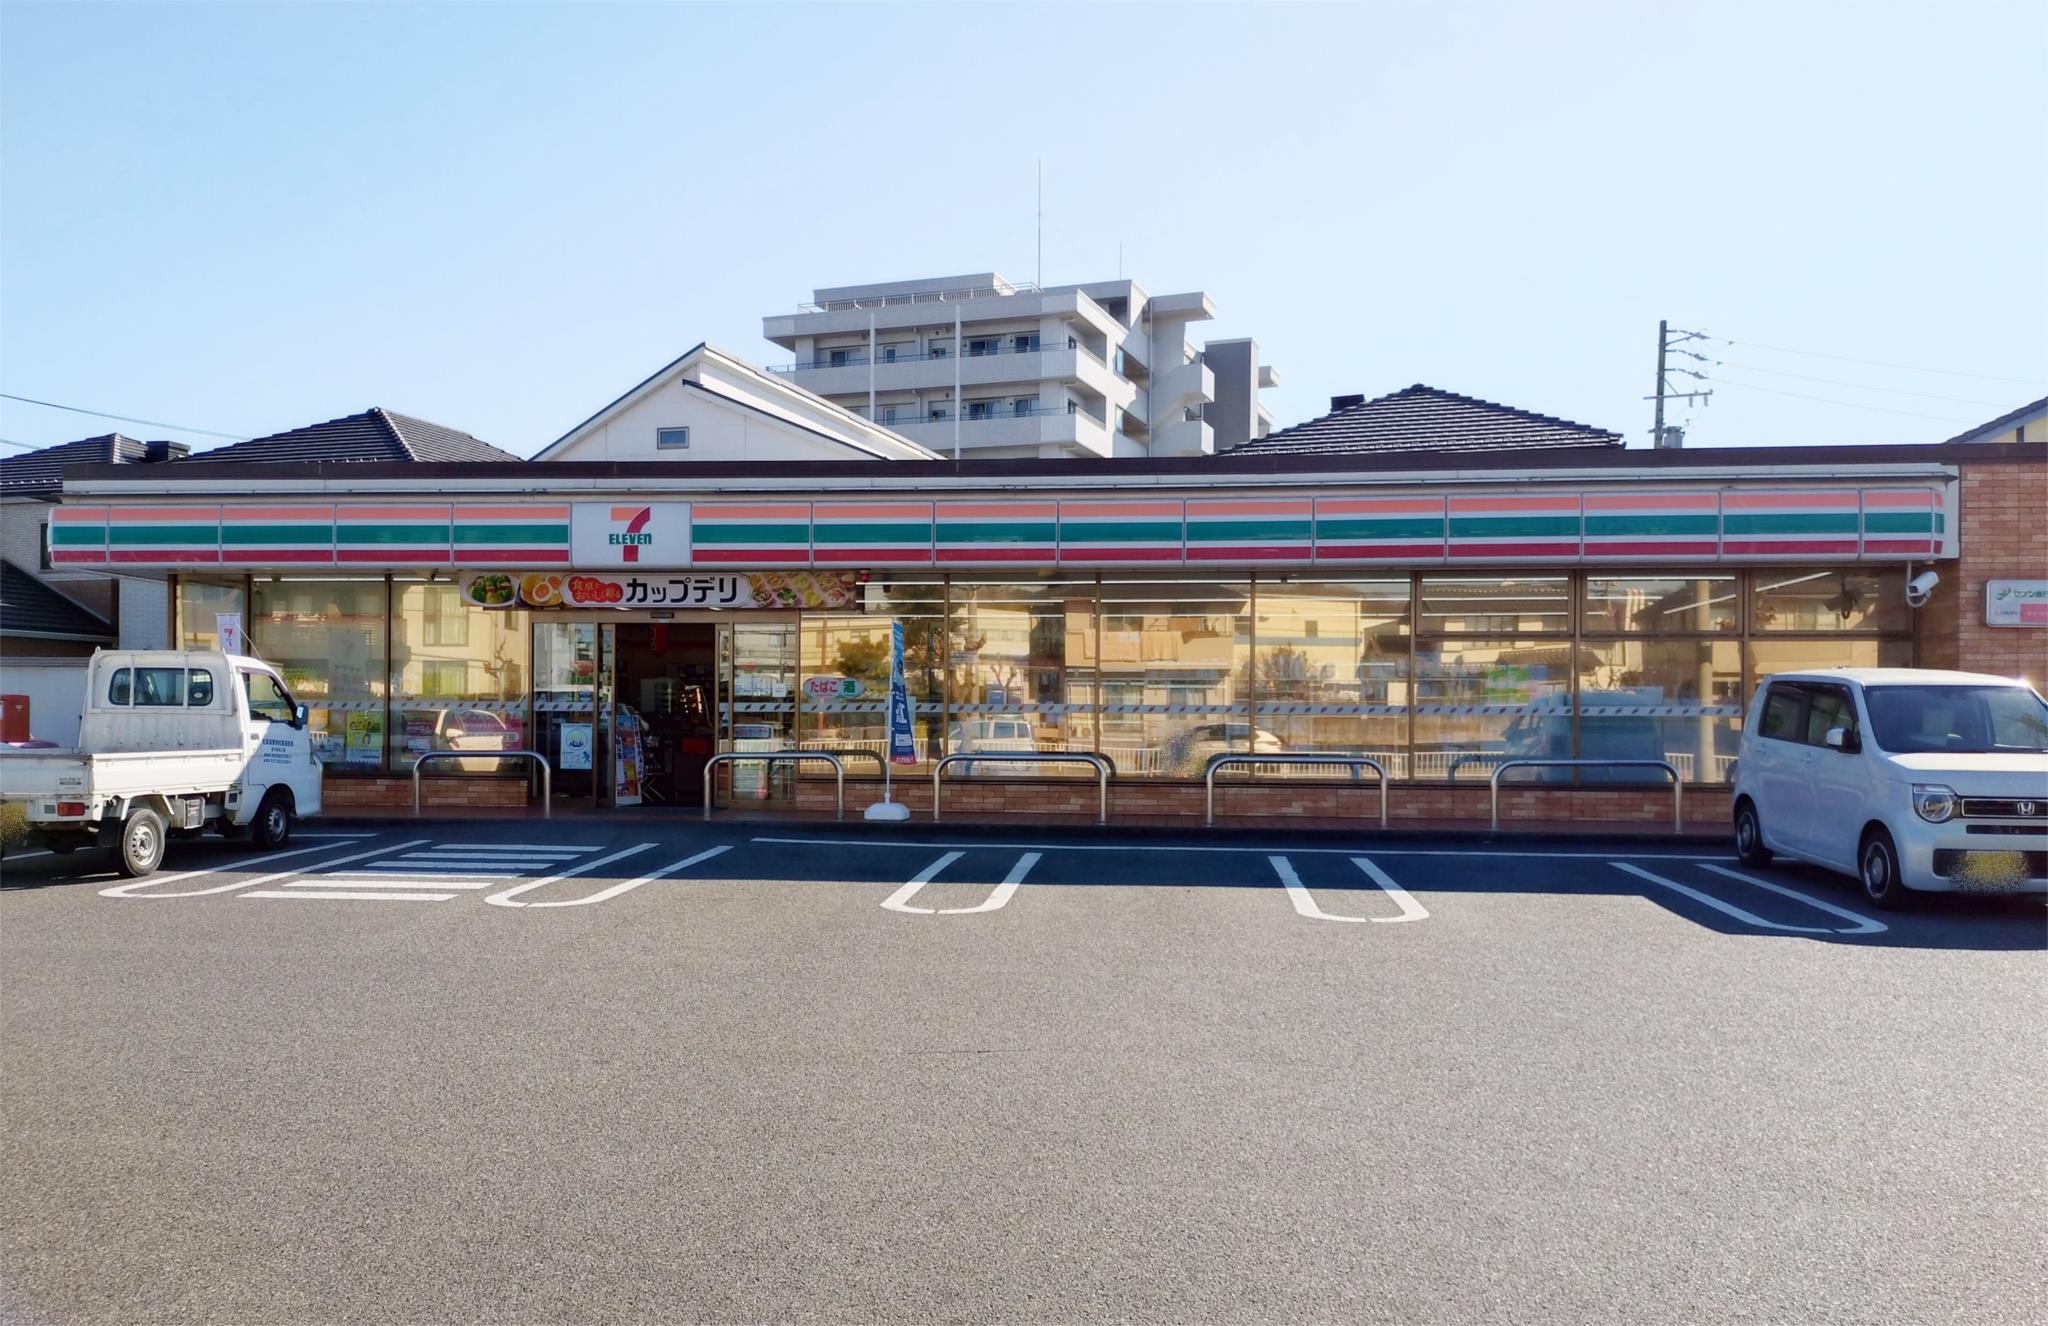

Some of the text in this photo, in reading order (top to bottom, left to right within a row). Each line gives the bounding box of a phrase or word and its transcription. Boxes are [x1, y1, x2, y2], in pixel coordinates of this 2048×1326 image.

[626, 577, 737, 603] カップデリ
[810, 680, 838, 693] たばこ
